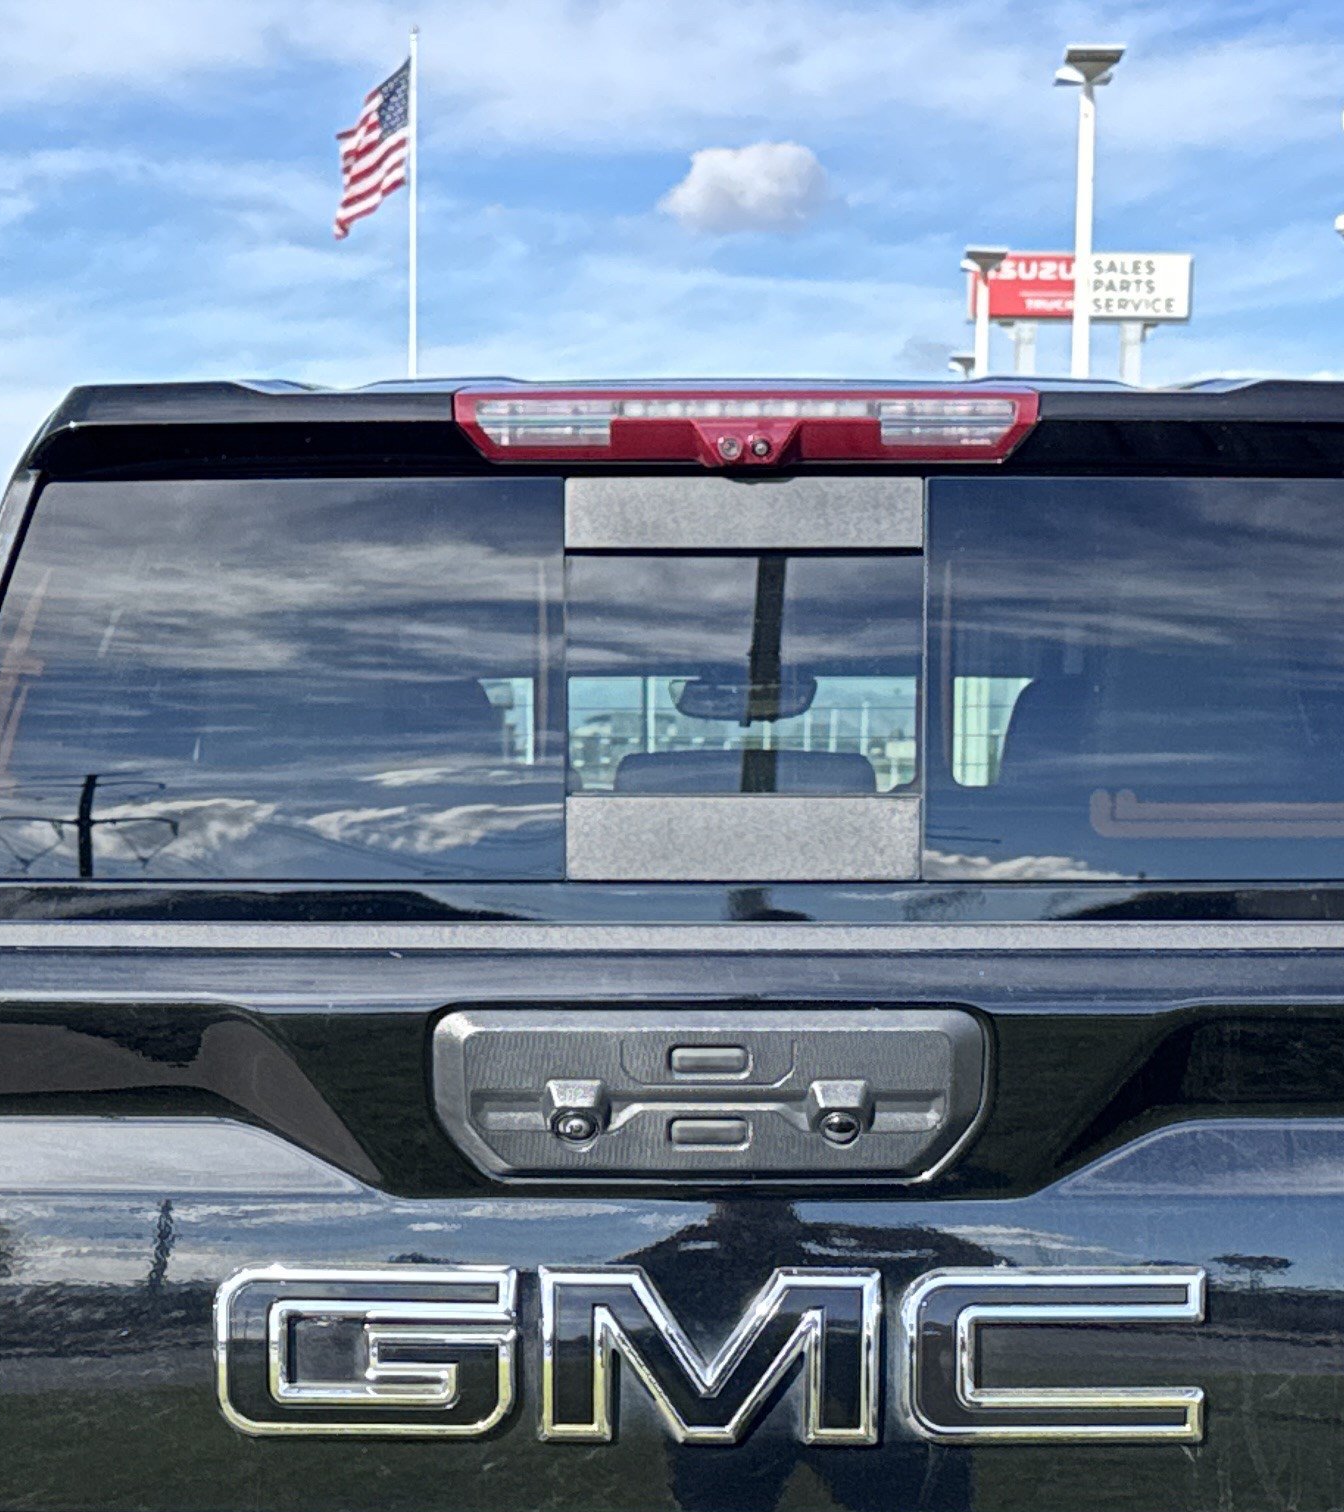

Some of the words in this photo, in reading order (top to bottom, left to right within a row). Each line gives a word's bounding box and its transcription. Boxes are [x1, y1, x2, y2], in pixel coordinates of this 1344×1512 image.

[1094, 260, 1155, 275] SALES
[1093, 279, 1155, 294] PARTS
[1092, 298, 1175, 313] SERVICE
[214, 1264, 1208, 1446] GMC
